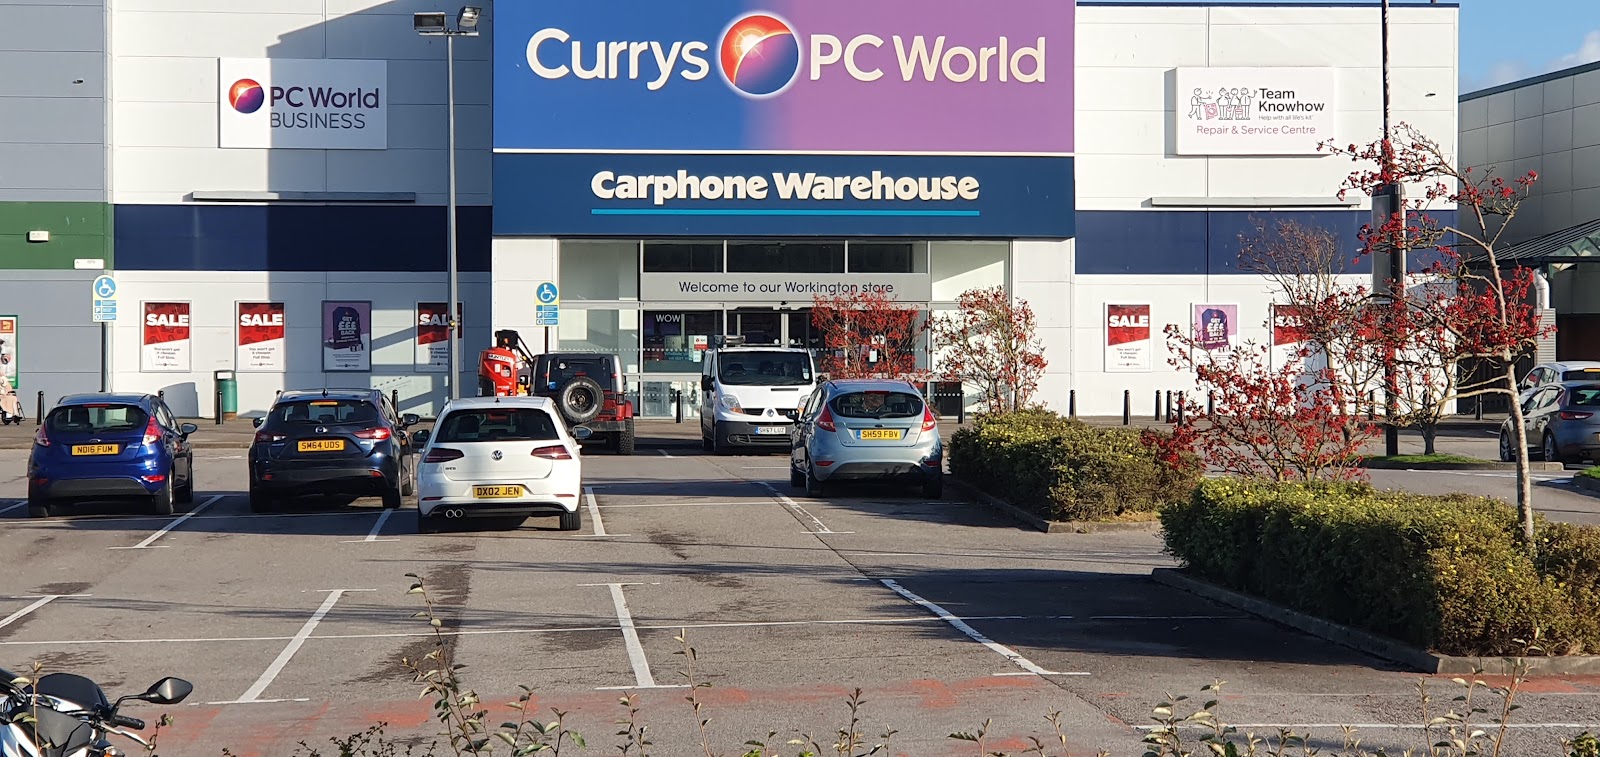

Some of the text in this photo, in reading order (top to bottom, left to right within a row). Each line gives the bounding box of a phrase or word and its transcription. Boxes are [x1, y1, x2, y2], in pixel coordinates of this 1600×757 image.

[526, 27, 1046, 91] Currys PC World
[270, 86, 379, 109] PC World
[1258, 87, 1295, 100] Team
[1258, 100, 1325, 112] Knowhow
[270, 112, 366, 129] BUSINESS
[1196, 125, 1316, 136] Repair & Service Centre
[590, 169, 980, 205] Carphone Warehouse
[678, 281, 894, 296] Welcome to our Workington store
[146, 313, 189, 327] SALE
[240, 313, 283, 327] SALE
[655, 314, 681, 323] WOW
[1109, 314, 1149, 327] SALE
[862, 430, 898, 438] SH59 FBV
[96, 445, 113, 453] FUM
[301, 441, 340, 450] SM64 UDS
[476, 486, 520, 496] DX02 JEN
